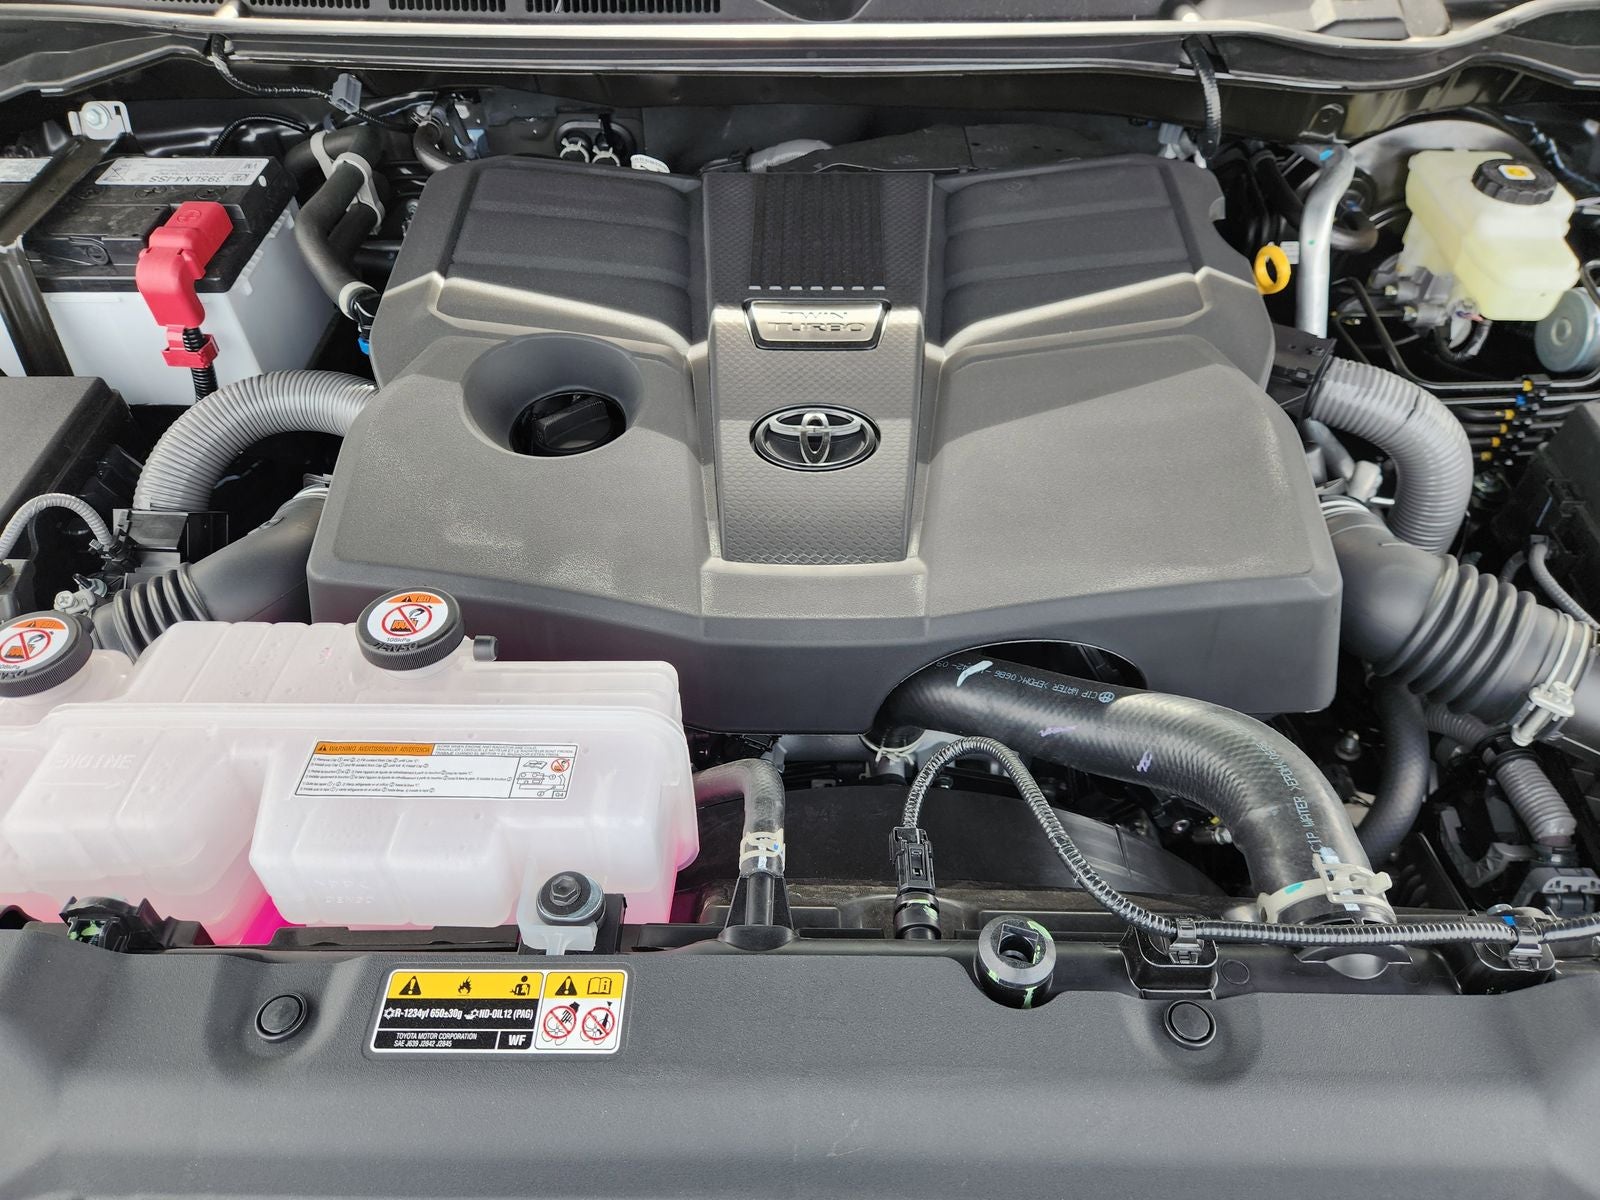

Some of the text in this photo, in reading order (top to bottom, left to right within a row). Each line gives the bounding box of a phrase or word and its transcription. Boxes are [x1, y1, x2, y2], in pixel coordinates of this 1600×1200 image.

[767, 321, 866, 332] TURBO
[394, 1008, 429, 1020] R-1234yf
[429, 1008, 463, 1020] 650±30g
[513, 1008, 534, 1021] (PAG)
[396, 1032, 478, 1041] TOYOTA MOTOR CORPORATION
[508, 1034, 527, 1046] WF
